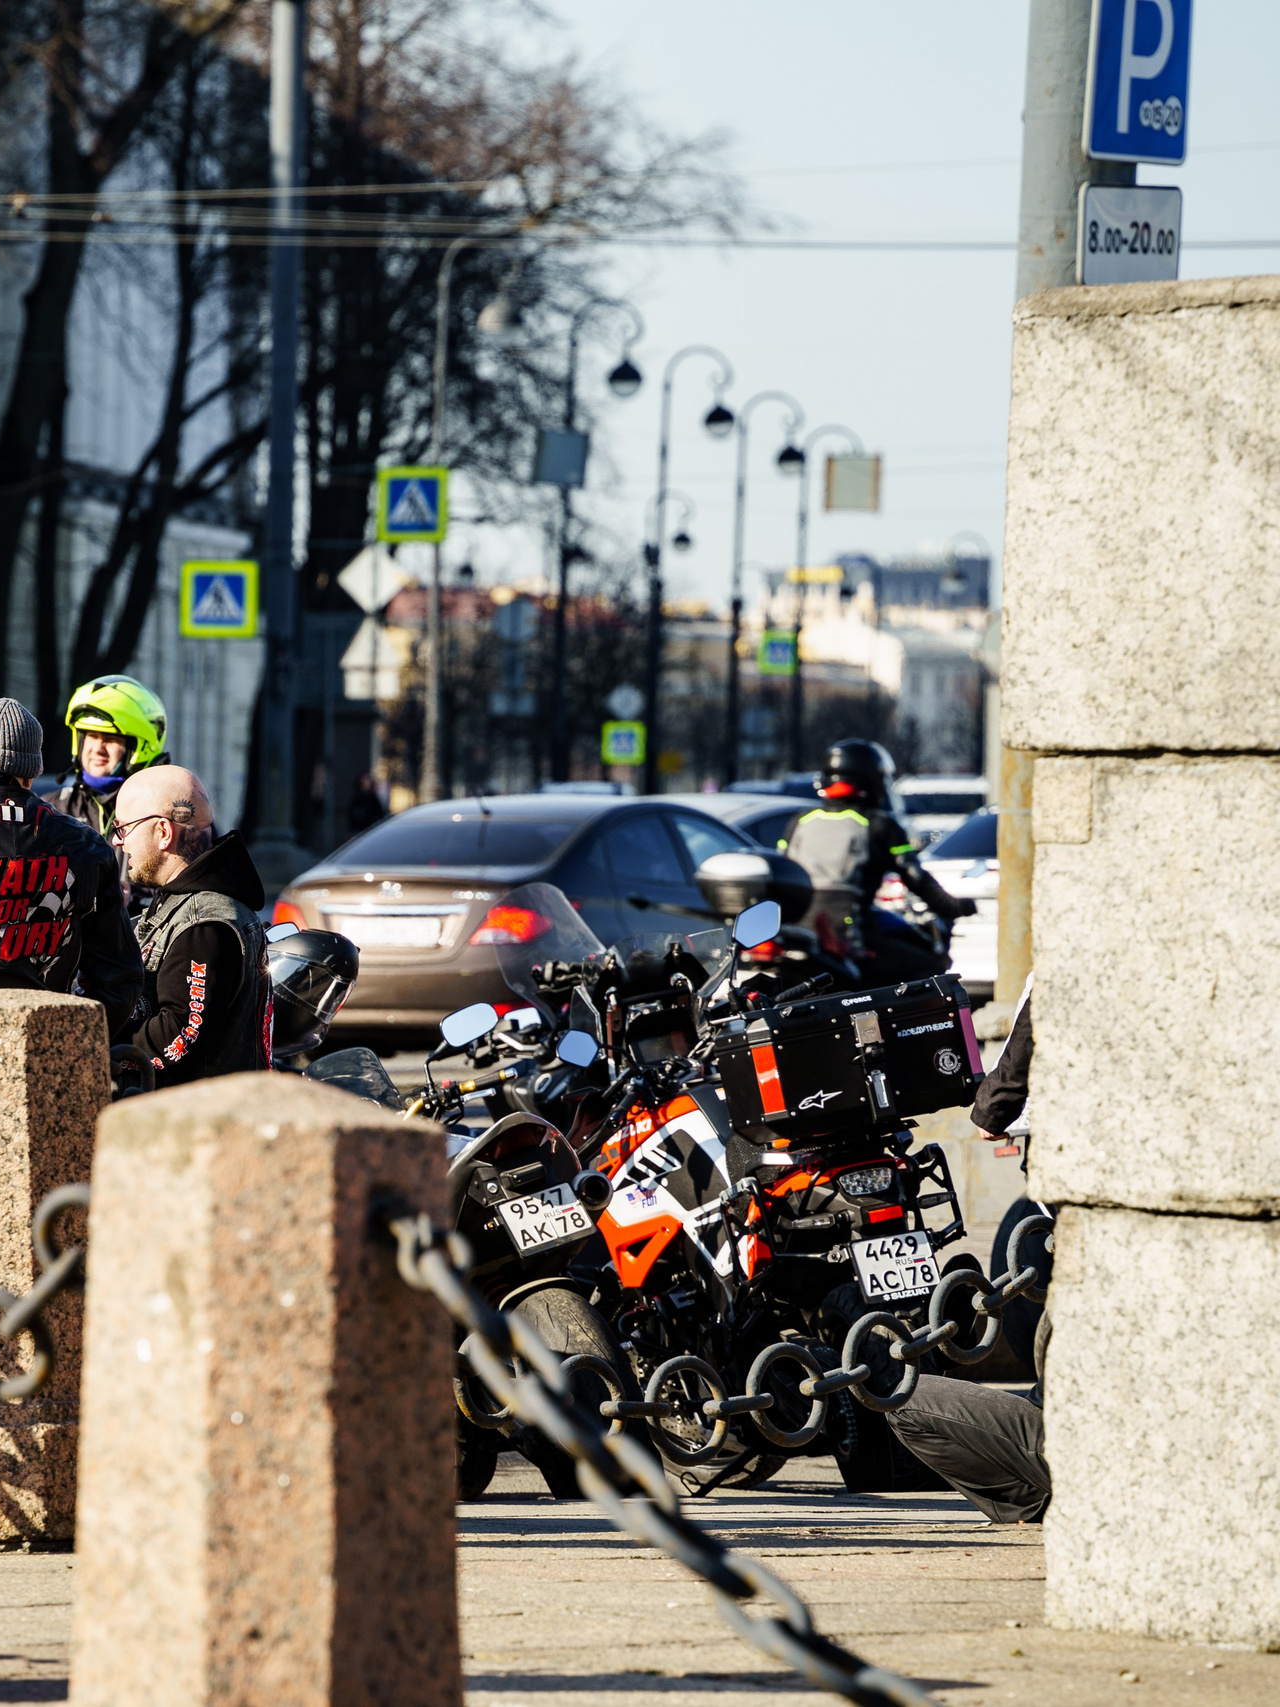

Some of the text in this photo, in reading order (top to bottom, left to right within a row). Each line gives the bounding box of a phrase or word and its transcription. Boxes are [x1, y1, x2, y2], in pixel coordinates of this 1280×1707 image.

[1116, 0, 1174, 134] P
[1088, 220, 1175, 255] 8.00-20.00
[510, 1187, 563, 1220] 9547
[544, 1208, 562, 1219] RUS
[555, 1212, 586, 1234] 78
[866, 1235, 919, 1261] 4429
[895, 1257, 913, 1266] RUS
[905, 1264, 934, 1286] 78
[890, 1287, 930, 1300] SUZUKI
